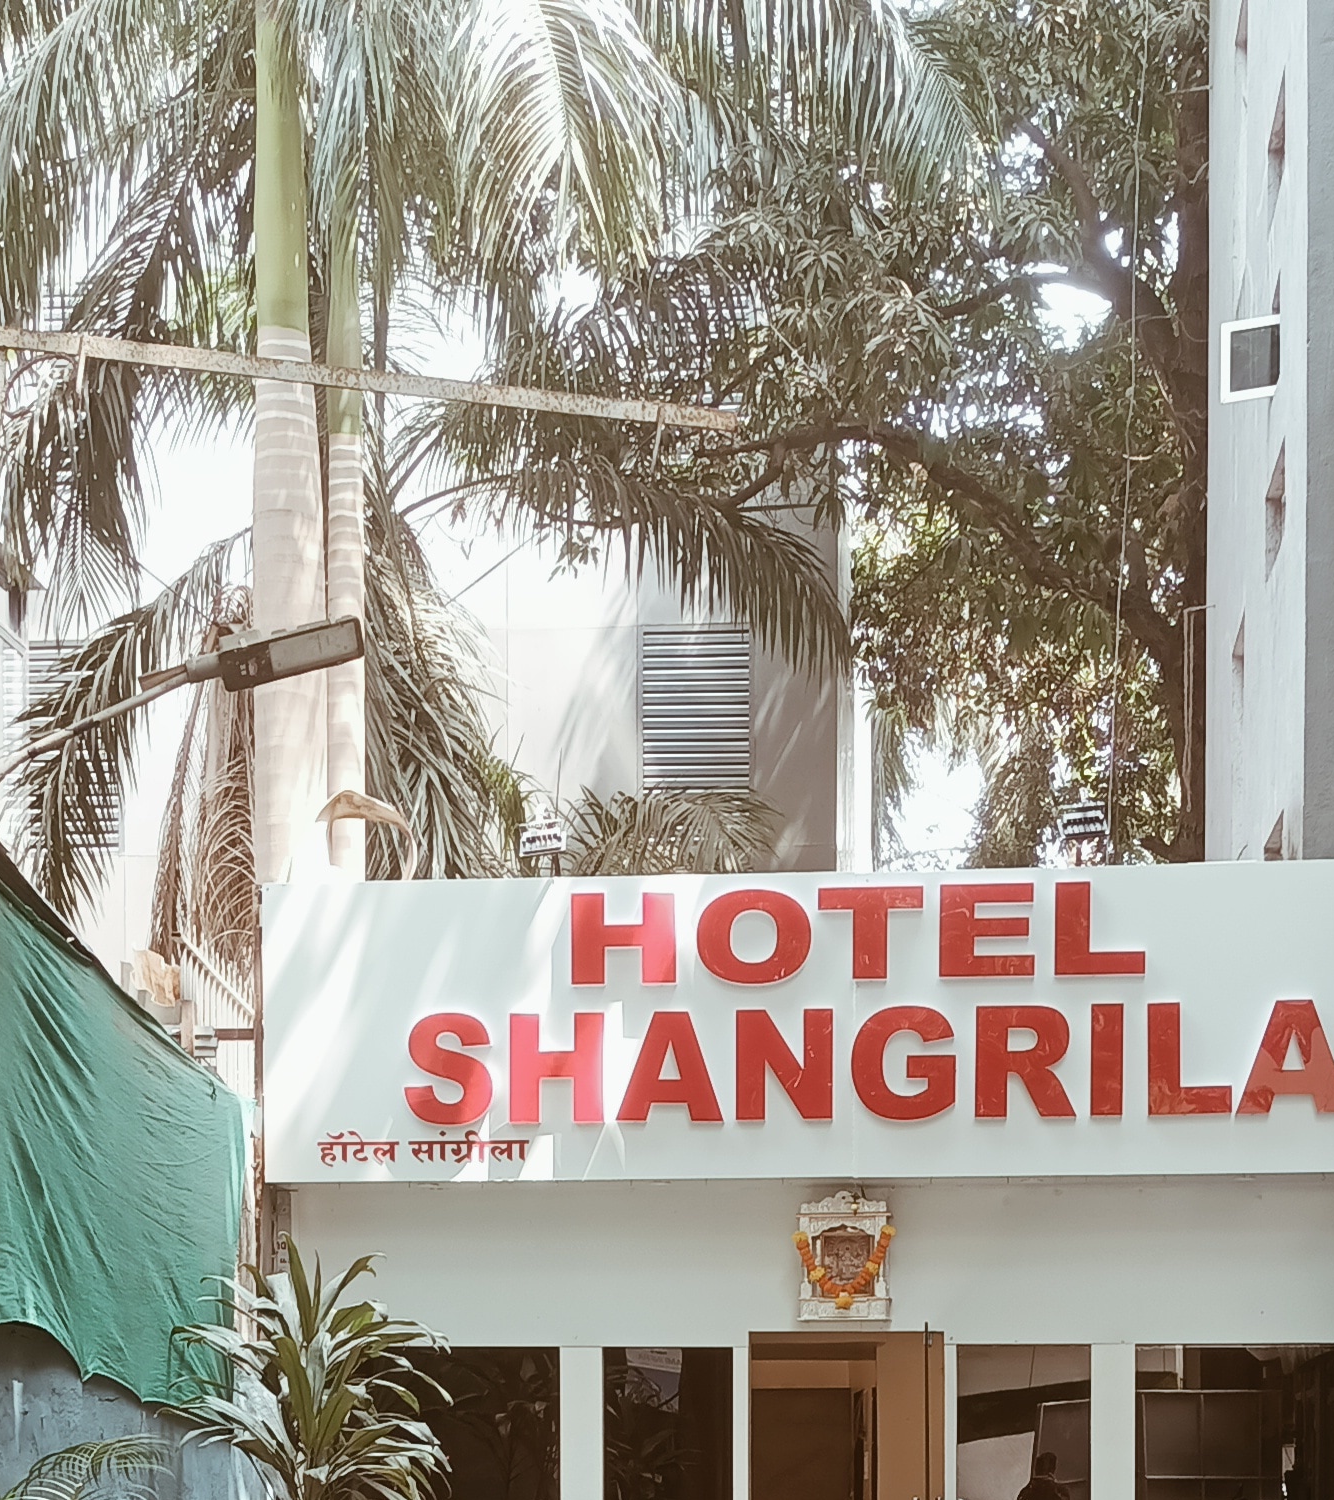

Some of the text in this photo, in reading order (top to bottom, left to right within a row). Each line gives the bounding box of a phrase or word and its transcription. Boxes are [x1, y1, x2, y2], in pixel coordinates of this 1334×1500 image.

[570, 881, 1146, 986] HOTEL
[317, 1130, 529, 1167] हॉटेल सांग्रीला
